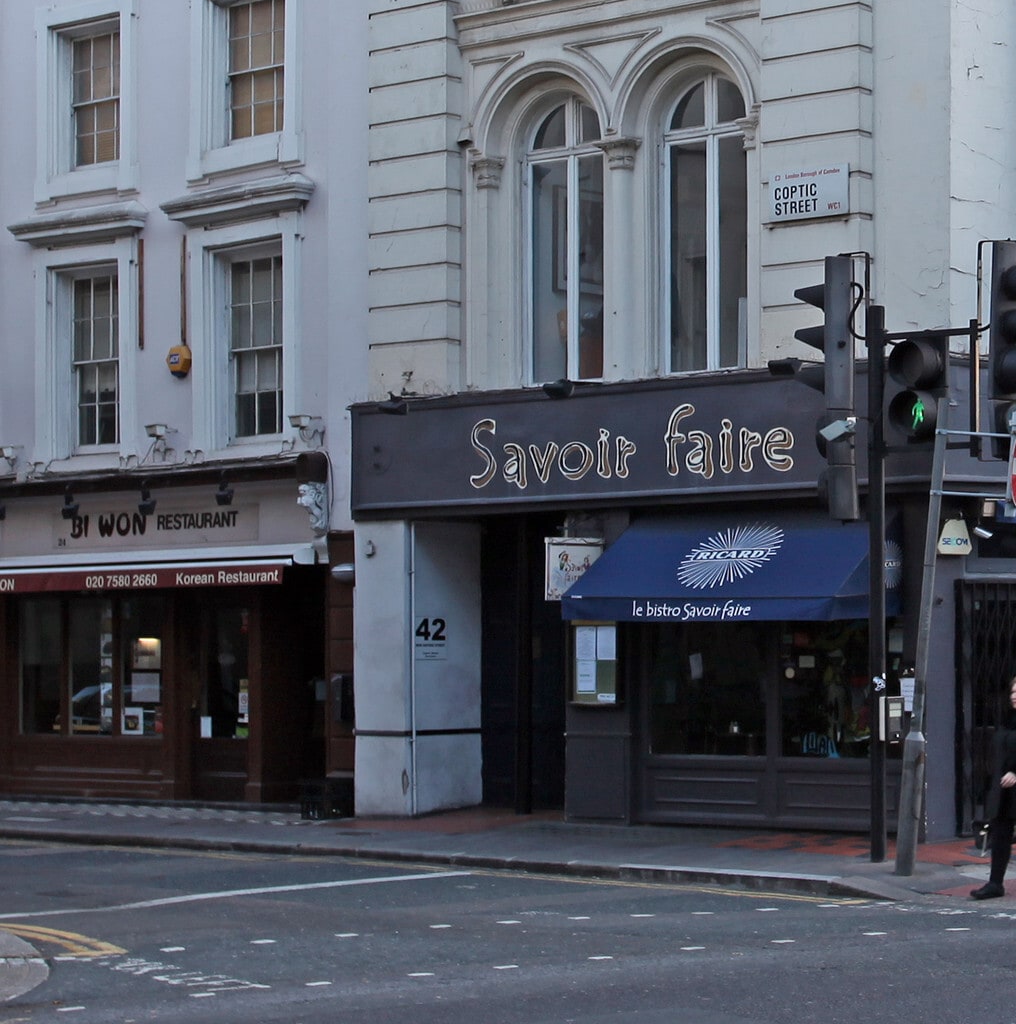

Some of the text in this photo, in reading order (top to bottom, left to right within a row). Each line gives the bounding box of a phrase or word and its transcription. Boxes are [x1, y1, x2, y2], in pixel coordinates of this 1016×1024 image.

[774, 183, 817, 201] COPTIC
[775, 198, 841, 216] STREET WC1
[470, 404, 794, 488] Savoir faire
[70, 511, 237, 538] BI WON RESTAURANT
[696, 550, 764, 560] RICARD
[85, 576, 104, 588] 020
[107, 575, 130, 587] 7580
[132, 574, 157, 585] 2660
[176, 573, 214, 585] Korean
[217, 570, 278, 584] Restaurant
[632, 600, 751, 620] le bistro Savoir faire
[415, 618, 446, 641] 42
